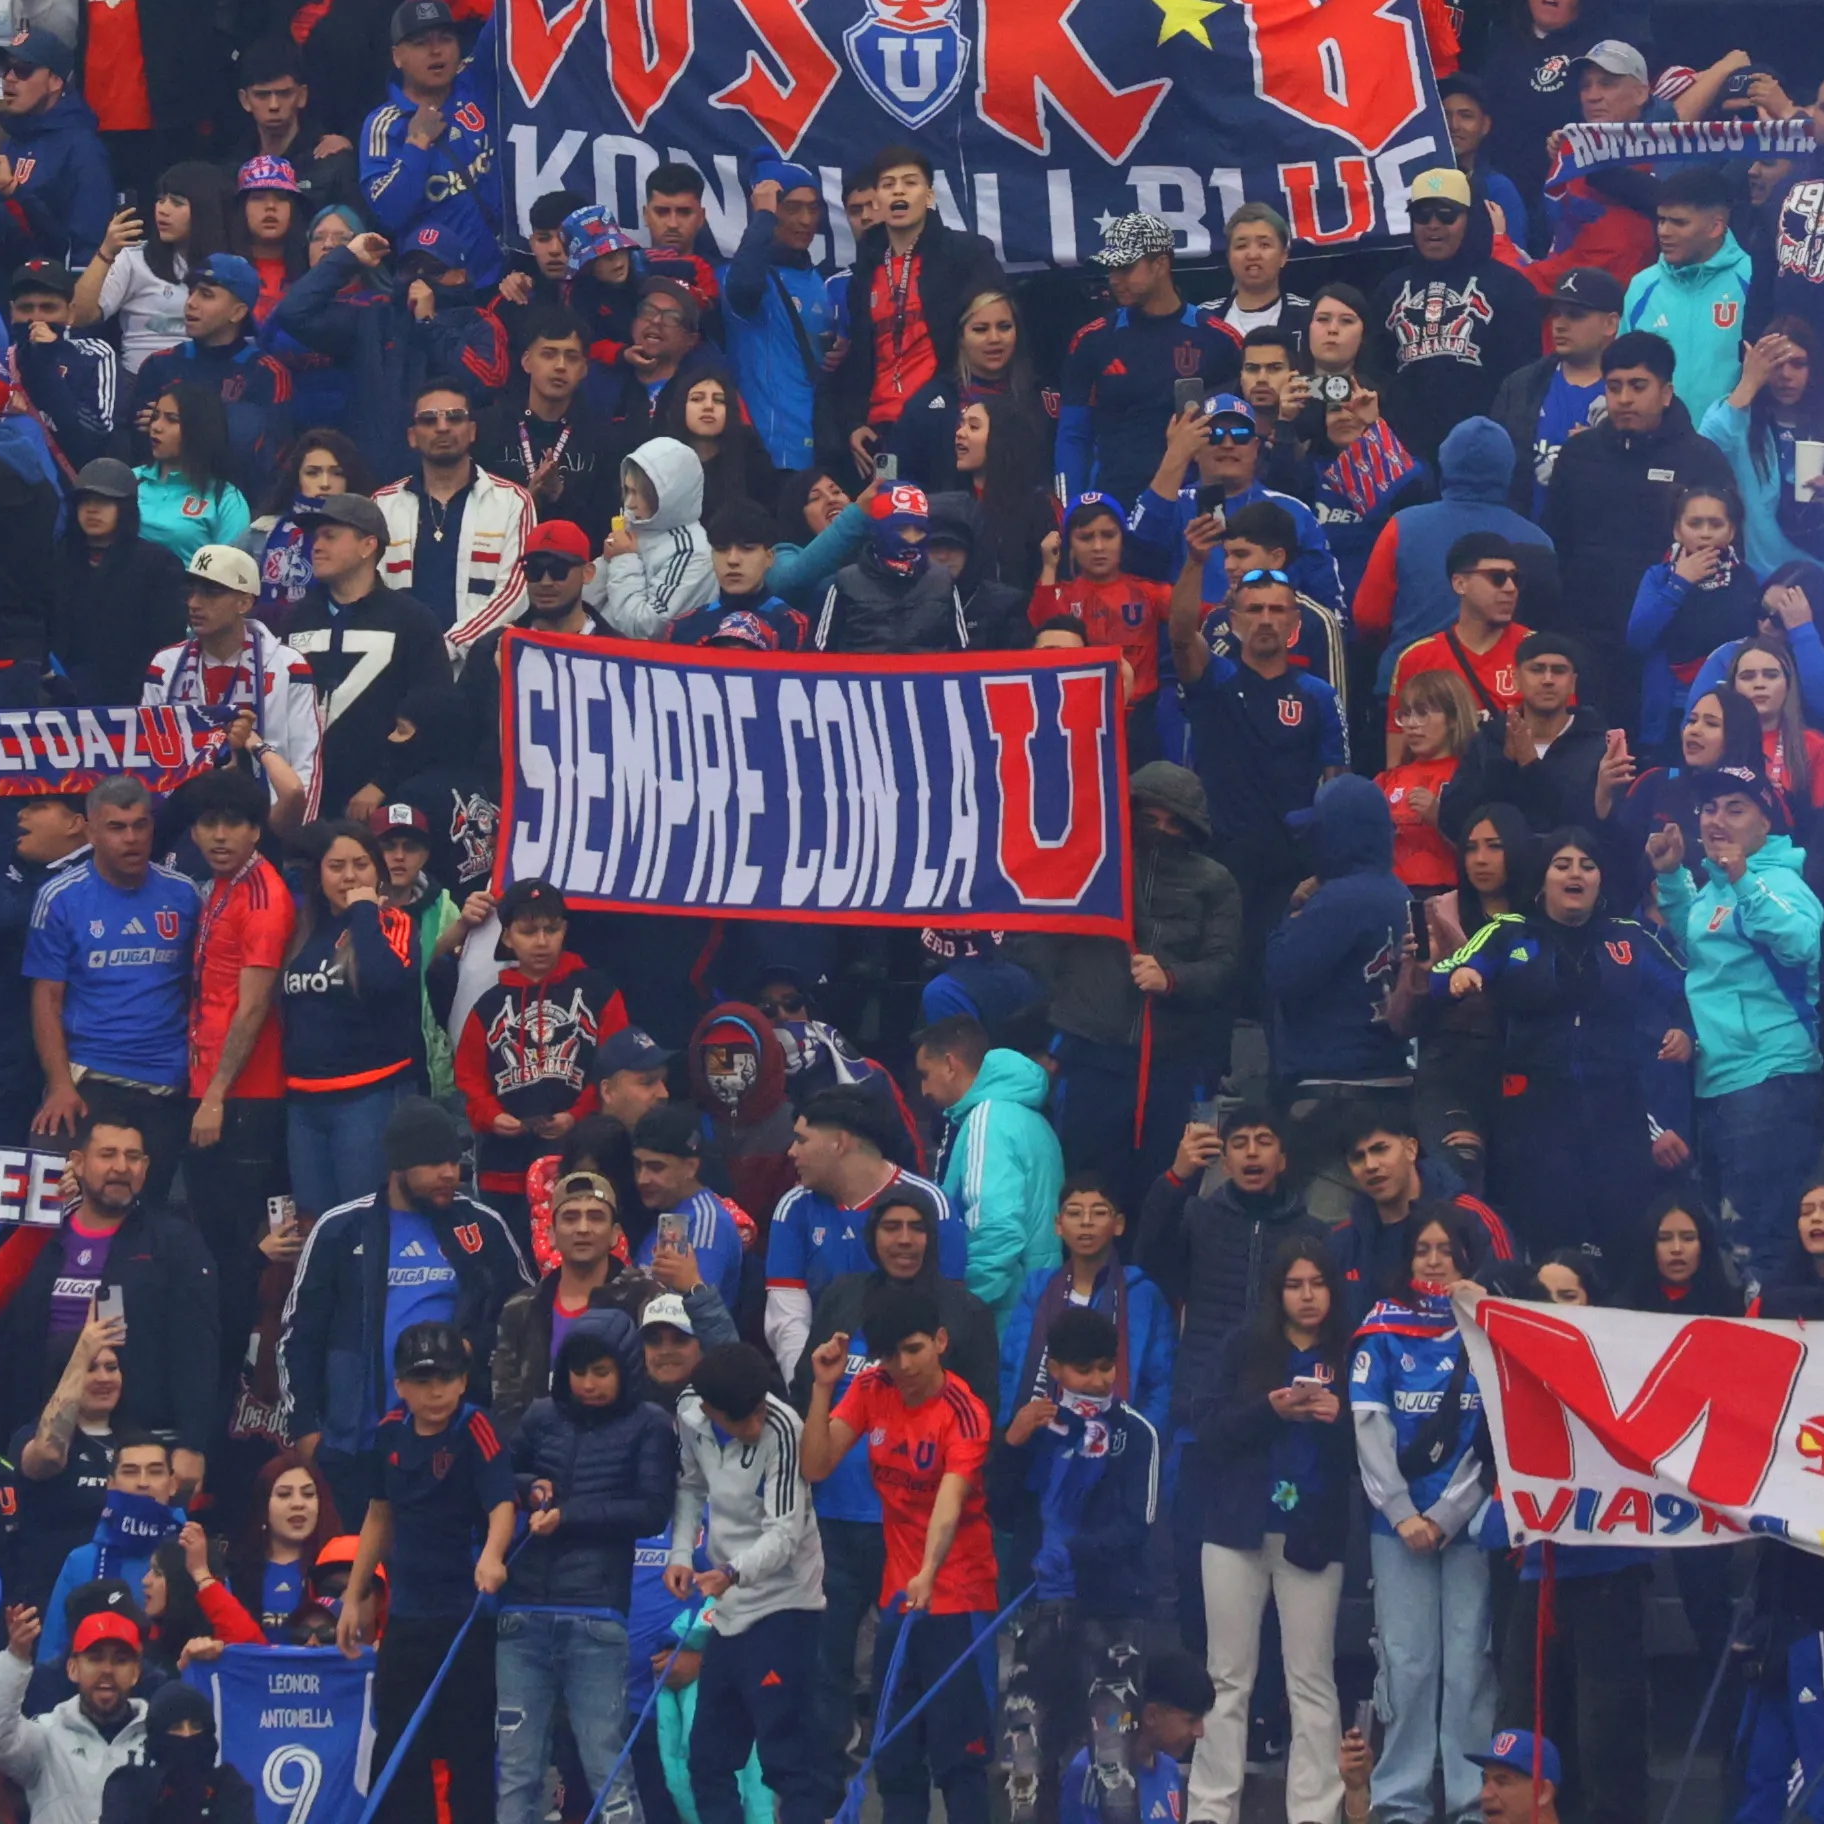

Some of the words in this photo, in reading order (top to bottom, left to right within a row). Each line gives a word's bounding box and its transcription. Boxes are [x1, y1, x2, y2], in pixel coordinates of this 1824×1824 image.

[514, 647, 765, 907] SIEMPRE
[781, 676, 900, 909] CON
[903, 680, 980, 909] LA
[980, 668, 1107, 908] U
[1476, 1299, 1807, 1506] M
[259, 1709, 334, 1729] ANTONELLA
[268, 1674, 320, 1695] LEONOR
[262, 1744, 322, 1824] 9
